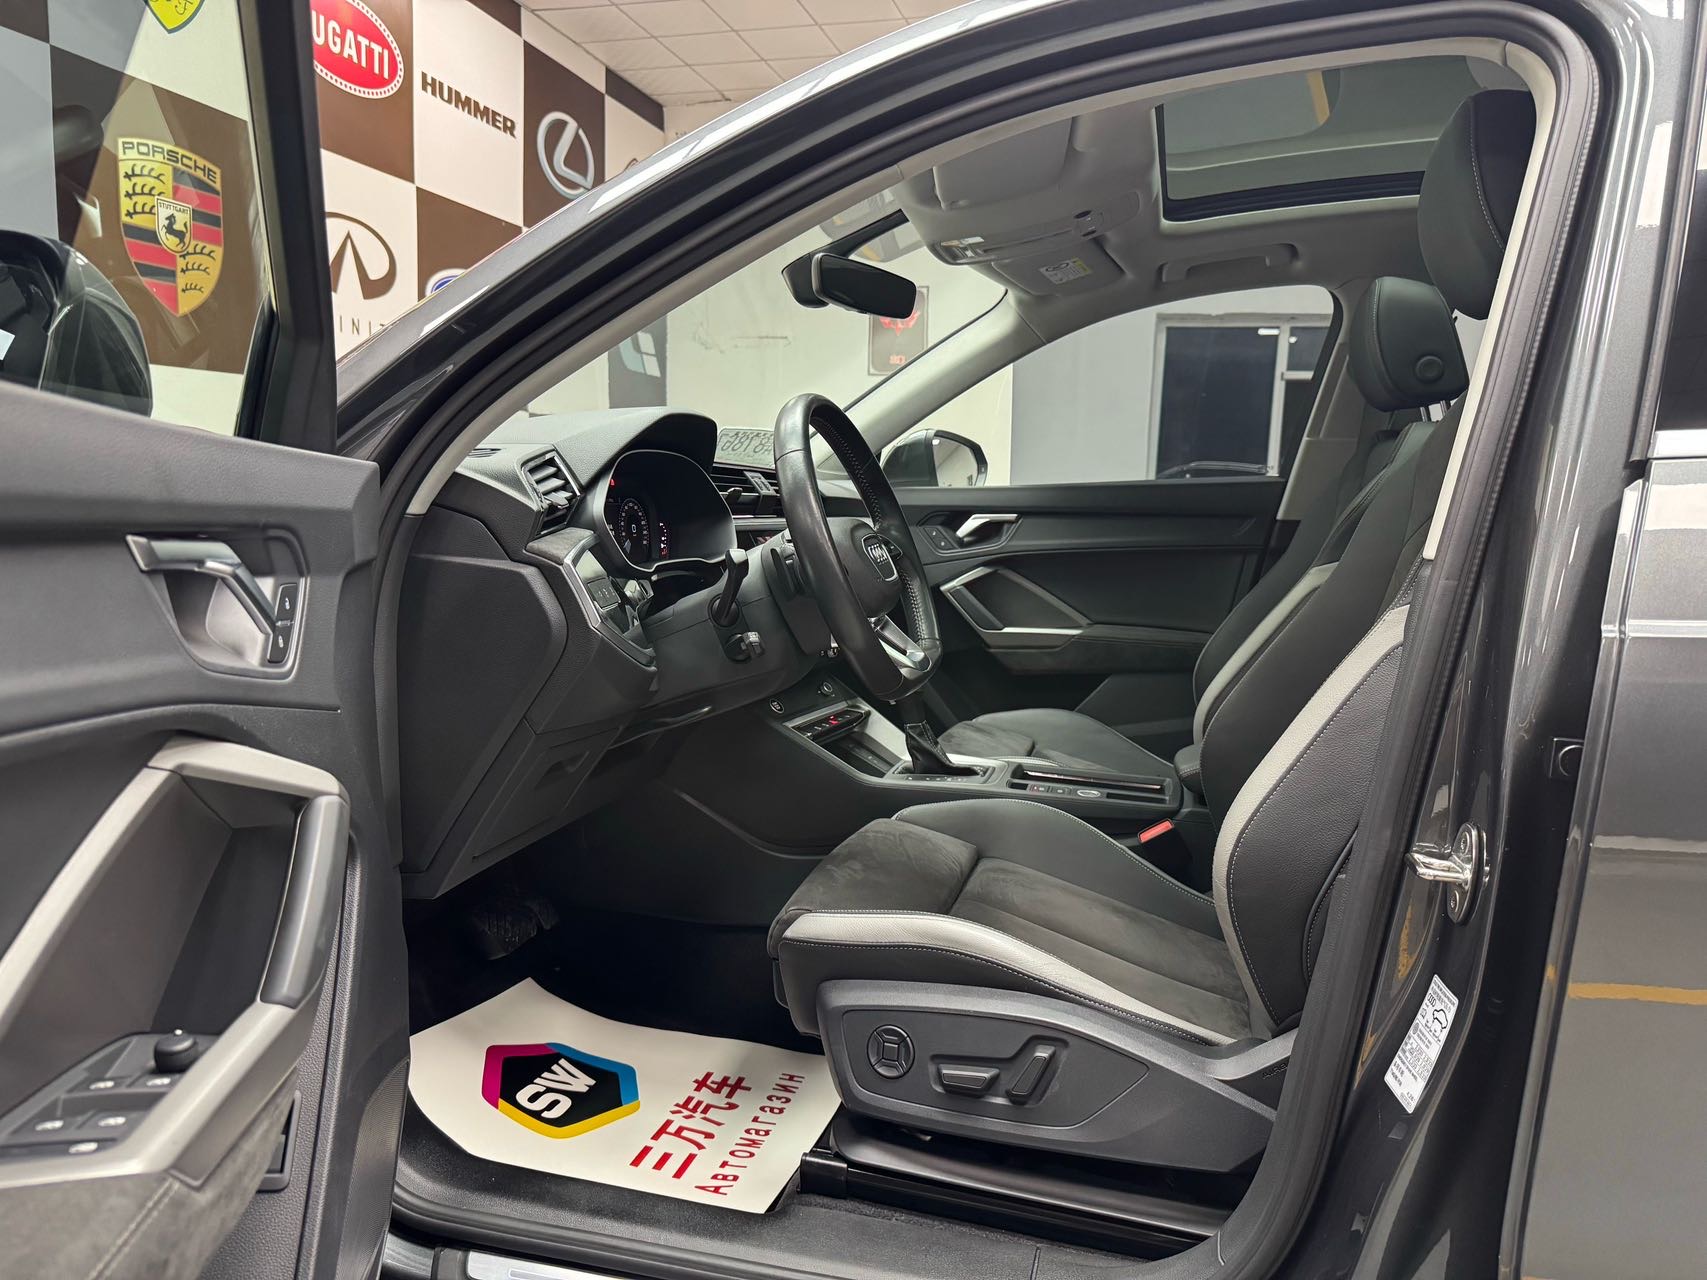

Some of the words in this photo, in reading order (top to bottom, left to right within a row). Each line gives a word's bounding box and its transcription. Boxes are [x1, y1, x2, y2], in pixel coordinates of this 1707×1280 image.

[311, 9, 390, 80] UGATTI
[420, 70, 517, 139] HUMMER
[121, 140, 217, 185] PORSCHE
[158, 201, 190, 215] STUTTGART
[515, 1057, 597, 1120] SW
[628, 1071, 753, 1180] 三万汽车
[693, 1072, 806, 1196] Автомагазин
